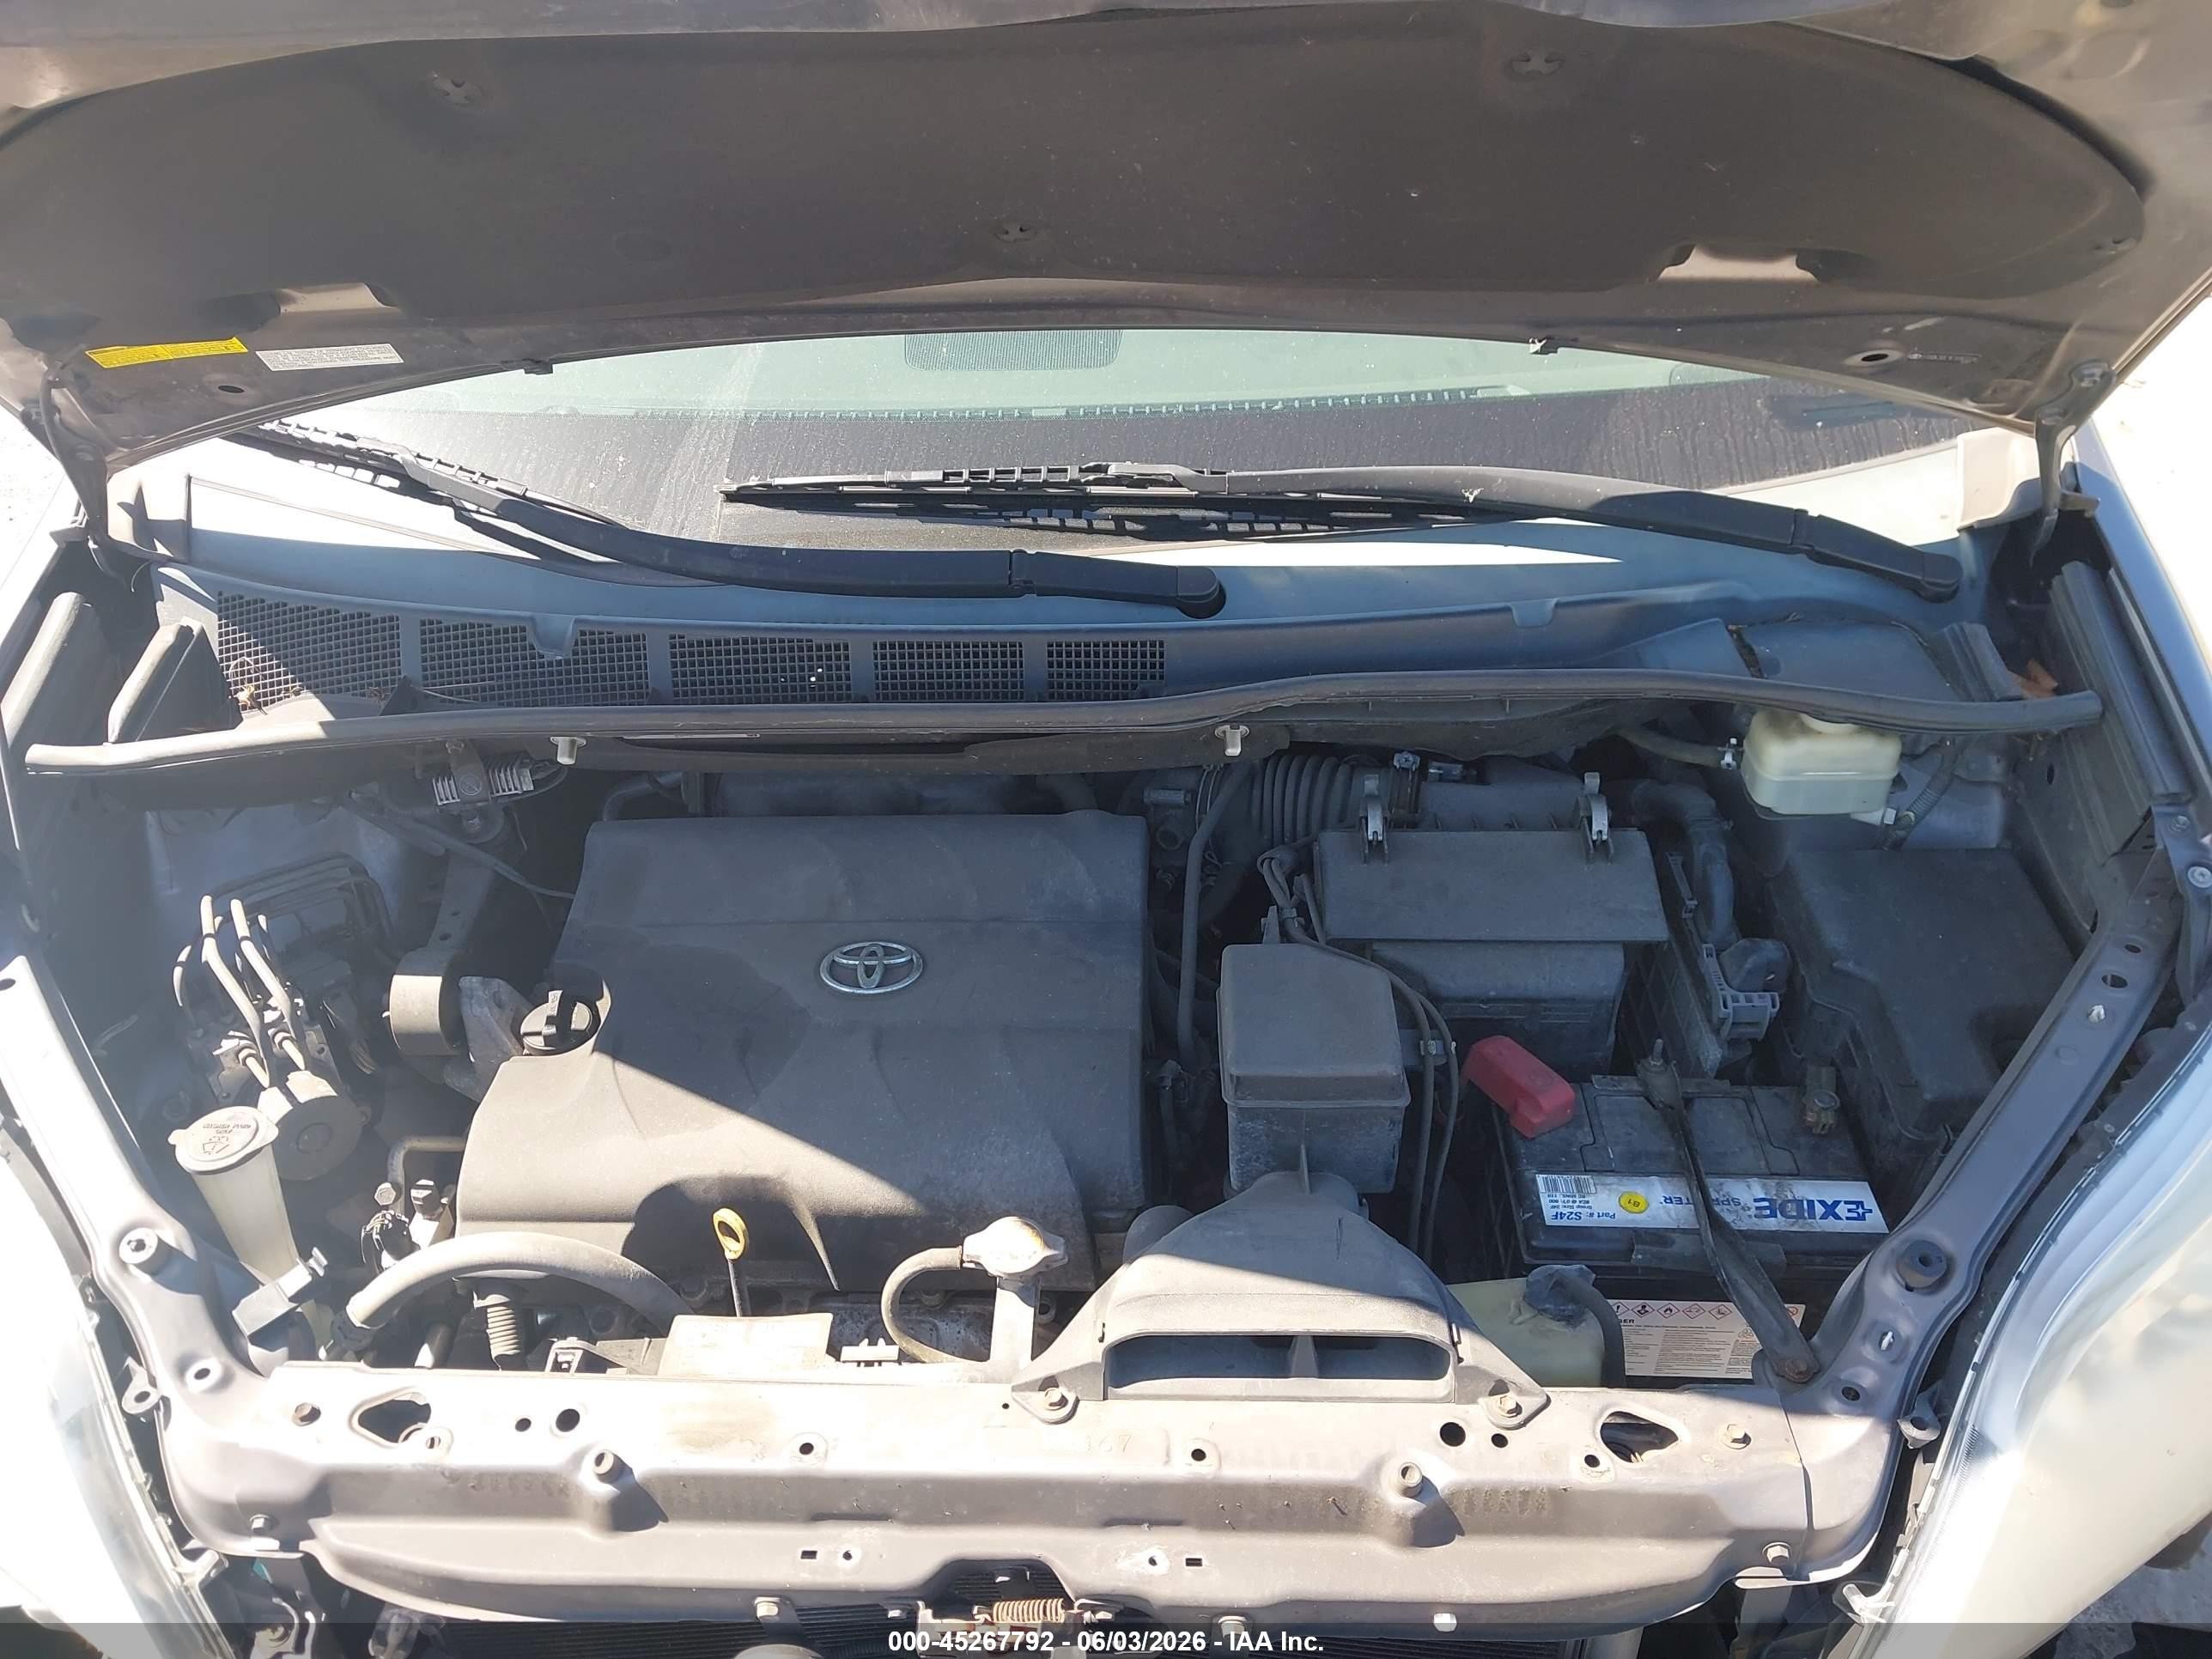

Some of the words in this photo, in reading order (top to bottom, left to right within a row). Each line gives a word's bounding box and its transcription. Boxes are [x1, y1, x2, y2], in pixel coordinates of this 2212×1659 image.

[1627, 1199, 1641, 1207] B1
[1662, 1195, 1741, 1206] SPRTER
[1753, 1197, 1872, 1221] EXIDE
[1551, 1211, 1583, 1221] S24F
[1597, 1211, 1616, 1219] Part
